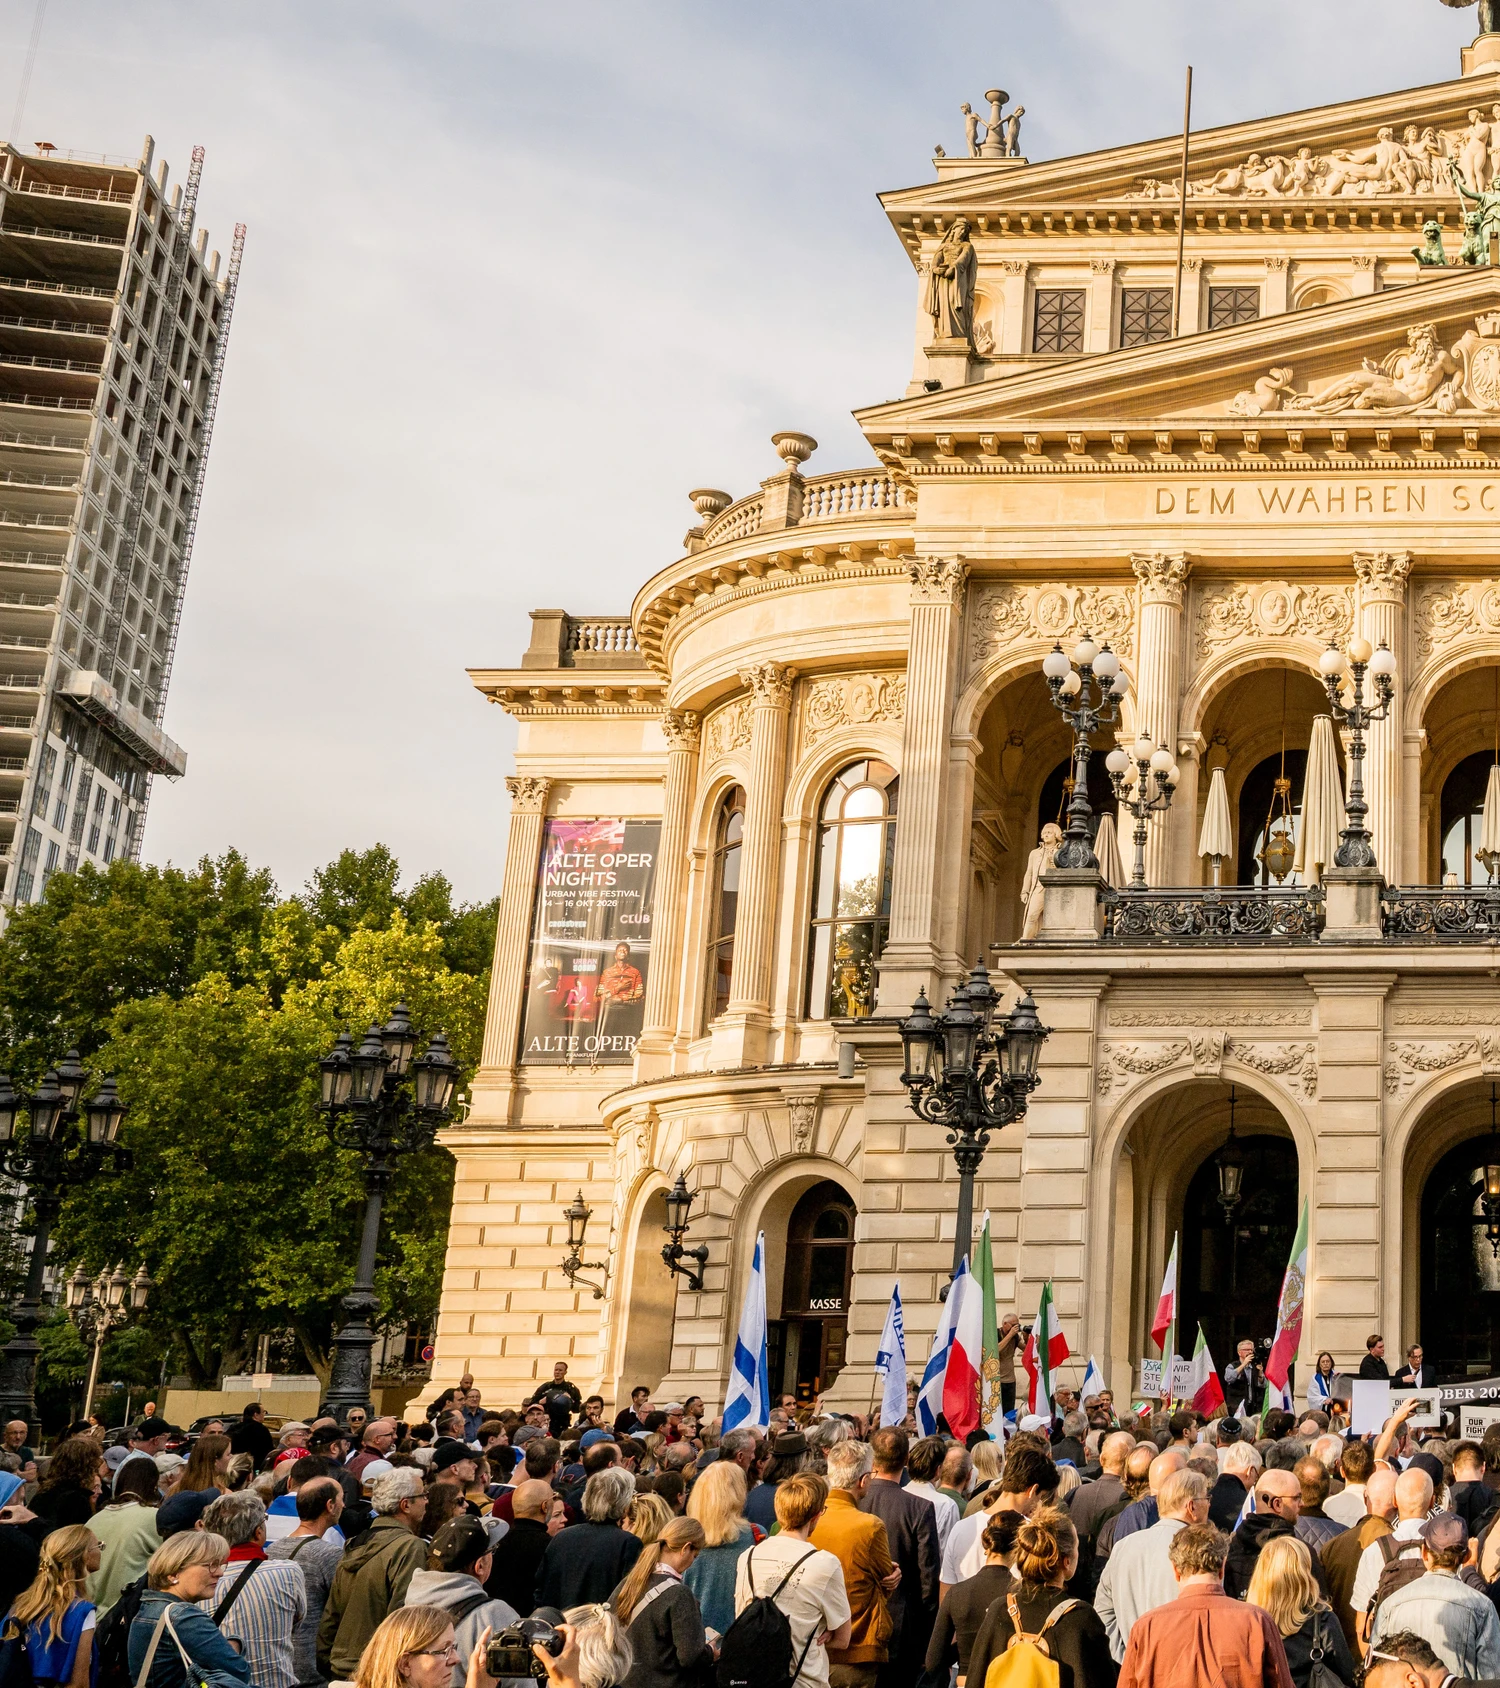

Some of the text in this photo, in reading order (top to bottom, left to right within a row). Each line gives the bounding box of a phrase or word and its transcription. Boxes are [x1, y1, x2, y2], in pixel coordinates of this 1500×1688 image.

[1155, 487, 1236, 515] DEM
[1257, 484, 1427, 515] WAHREN
[547, 853, 653, 868] ALTE OPER
[546, 871, 617, 886] NIGHTS
[545, 890, 640, 898] URBAN VIBE FESTIVAL
[620, 914, 651, 924] CLUB
[527, 1035, 636, 1052] ALTE OPER
[809, 1298, 842, 1310] KASSE
[1143, 1372, 1180, 1382] STEN
[1143, 1383, 1156, 1391] ZU
[1468, 1418, 1484, 1426] OUR
